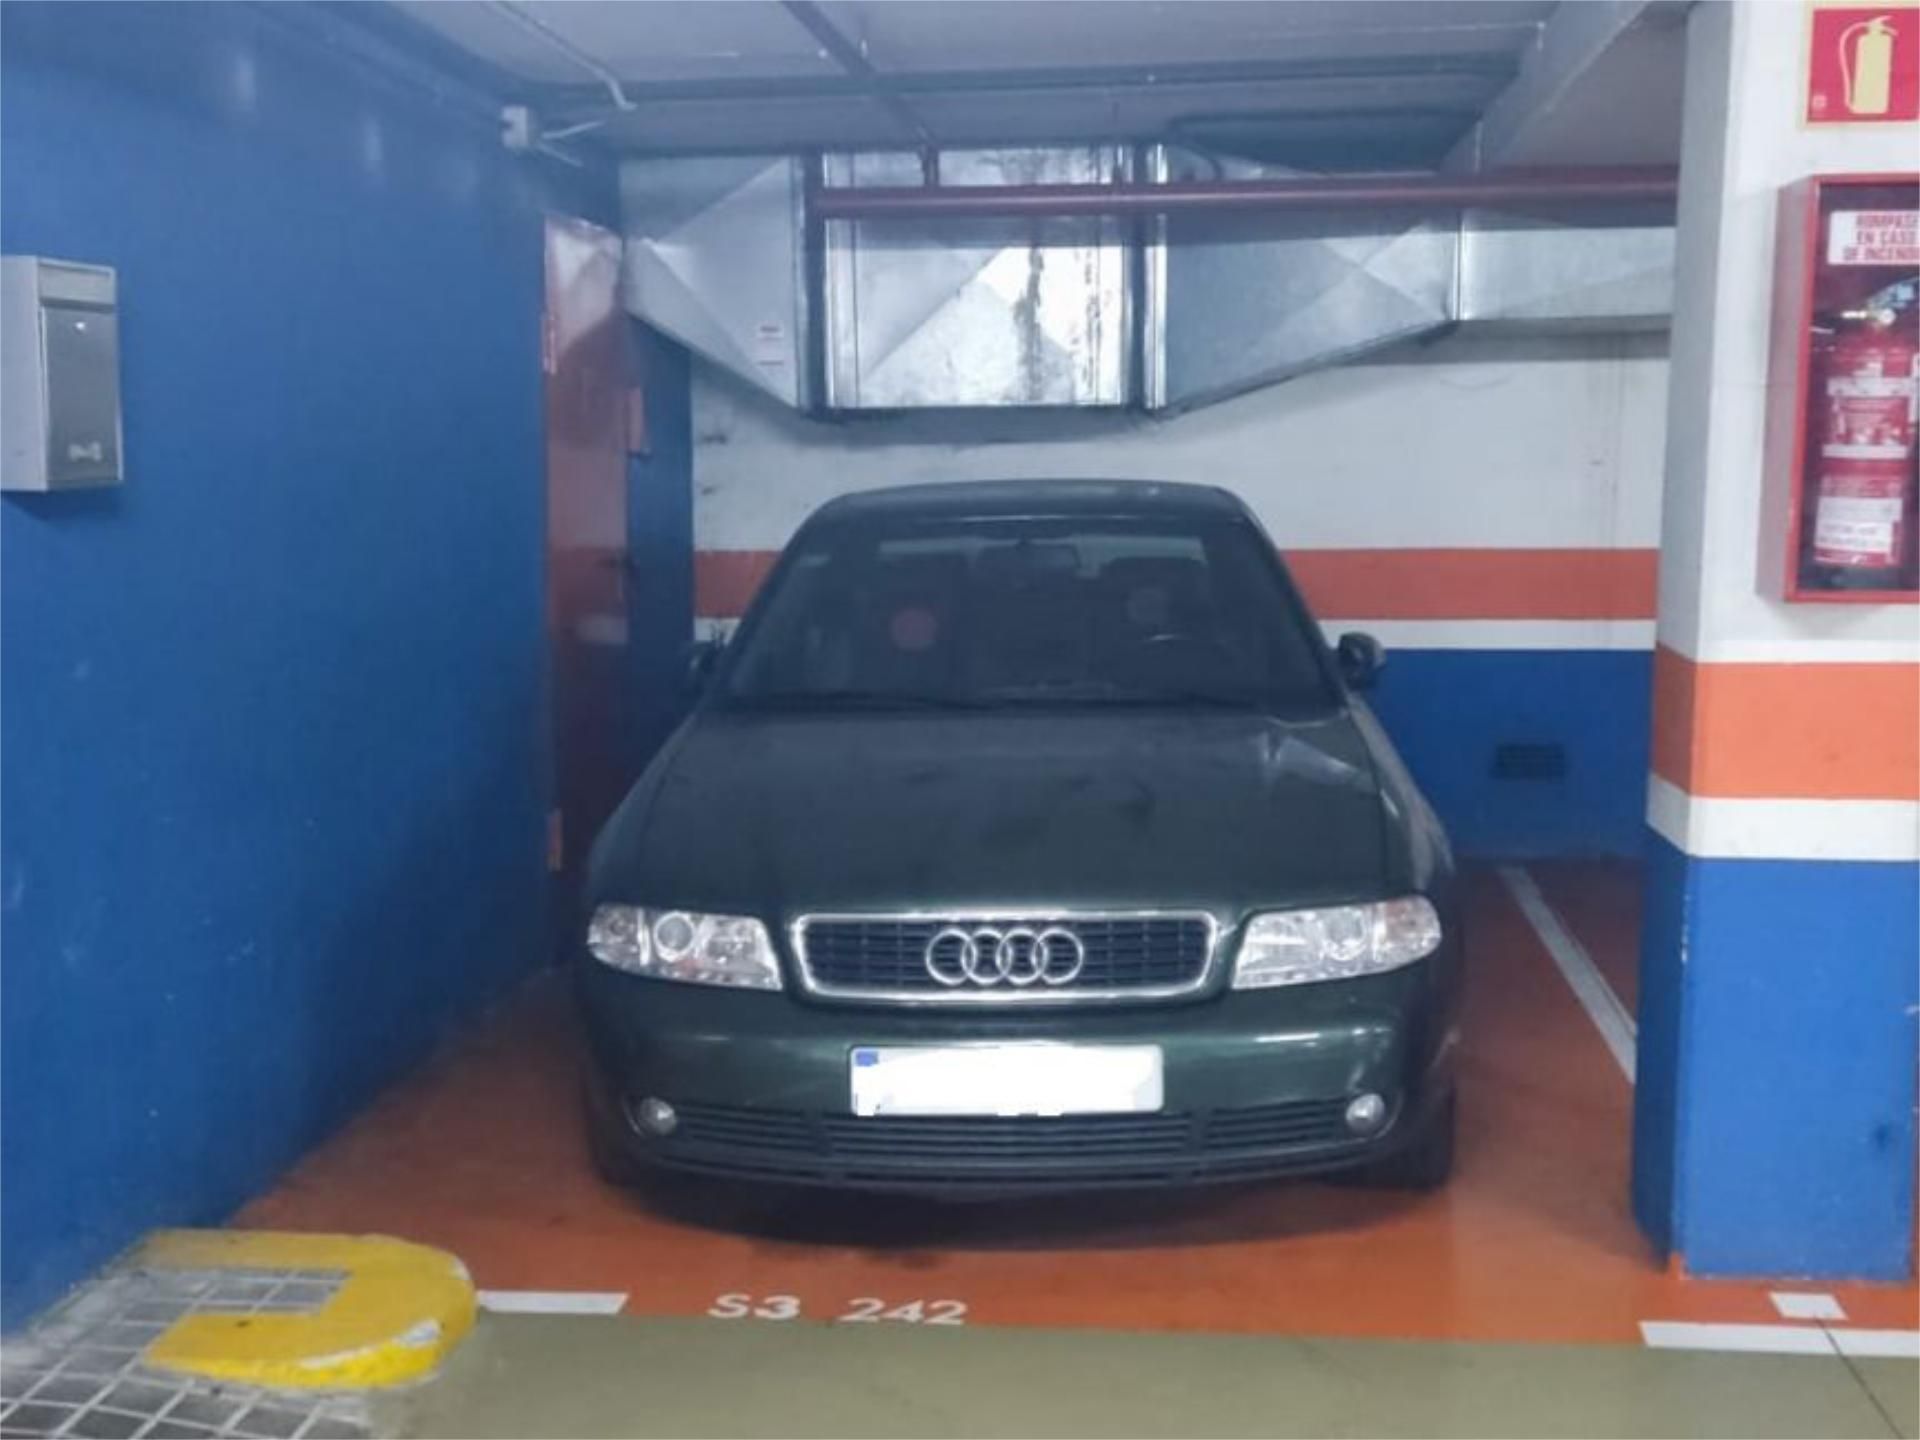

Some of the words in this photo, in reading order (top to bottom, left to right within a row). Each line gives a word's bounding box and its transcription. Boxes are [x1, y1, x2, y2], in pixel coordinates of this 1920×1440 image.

[1857, 230, 1876, 245] EN
[1881, 230, 1917, 245] CASO
[1864, 247, 1920, 261] INCENDI
[707, 1293, 801, 1320] S3
[839, 1297, 968, 1325] 242
